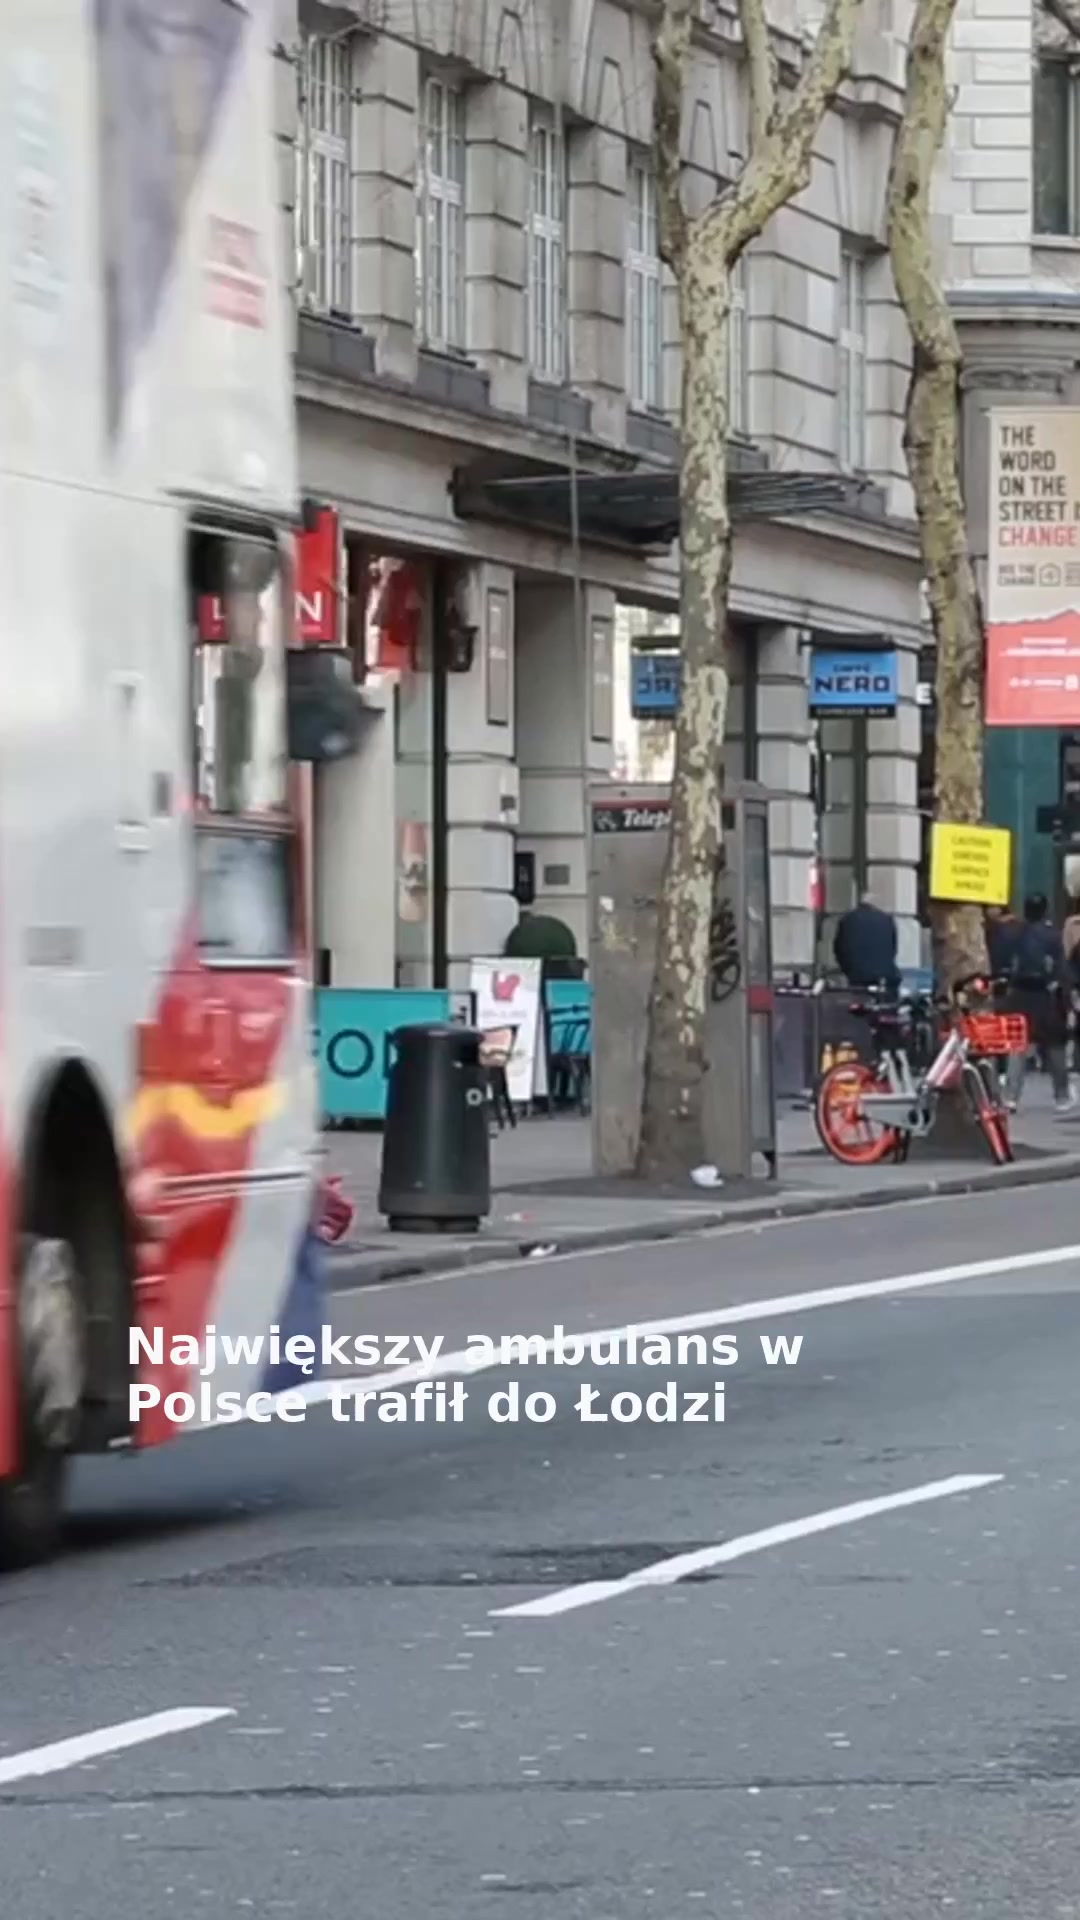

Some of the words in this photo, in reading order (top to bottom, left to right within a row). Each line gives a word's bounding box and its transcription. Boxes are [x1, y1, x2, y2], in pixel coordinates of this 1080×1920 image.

[1000, 425, 1035, 447] THE
[1000, 449, 1056, 471] WORD
[999, 476, 1024, 496] ON
[1031, 475, 1067, 496] THE
[999, 501, 1067, 521] STREET
[999, 526, 1077, 547] CHANGE
[815, 676, 890, 692] NERO
